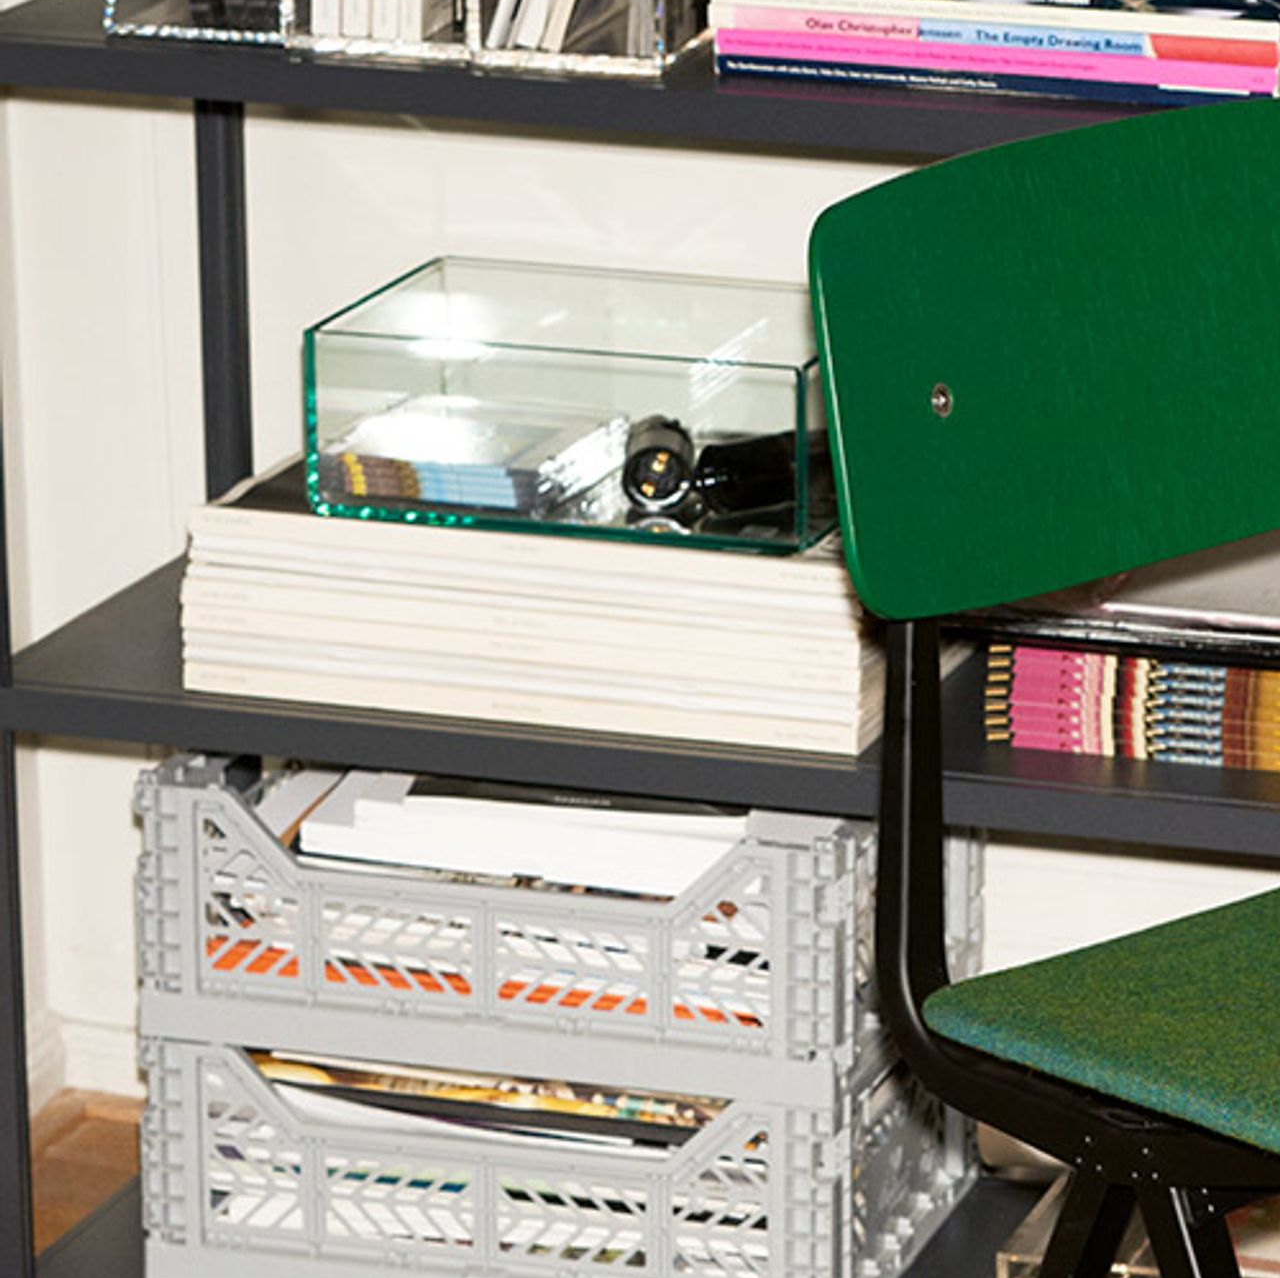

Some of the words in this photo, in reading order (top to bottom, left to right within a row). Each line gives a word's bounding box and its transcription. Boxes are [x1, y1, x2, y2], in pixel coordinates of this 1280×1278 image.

[837, 18, 913, 37] Christopher
[975, 28, 999, 41] The
[1002, 30, 1045, 48] Empty
[1048, 33, 1101, 51] Drawing
[1104, 38, 1143, 52] Room
